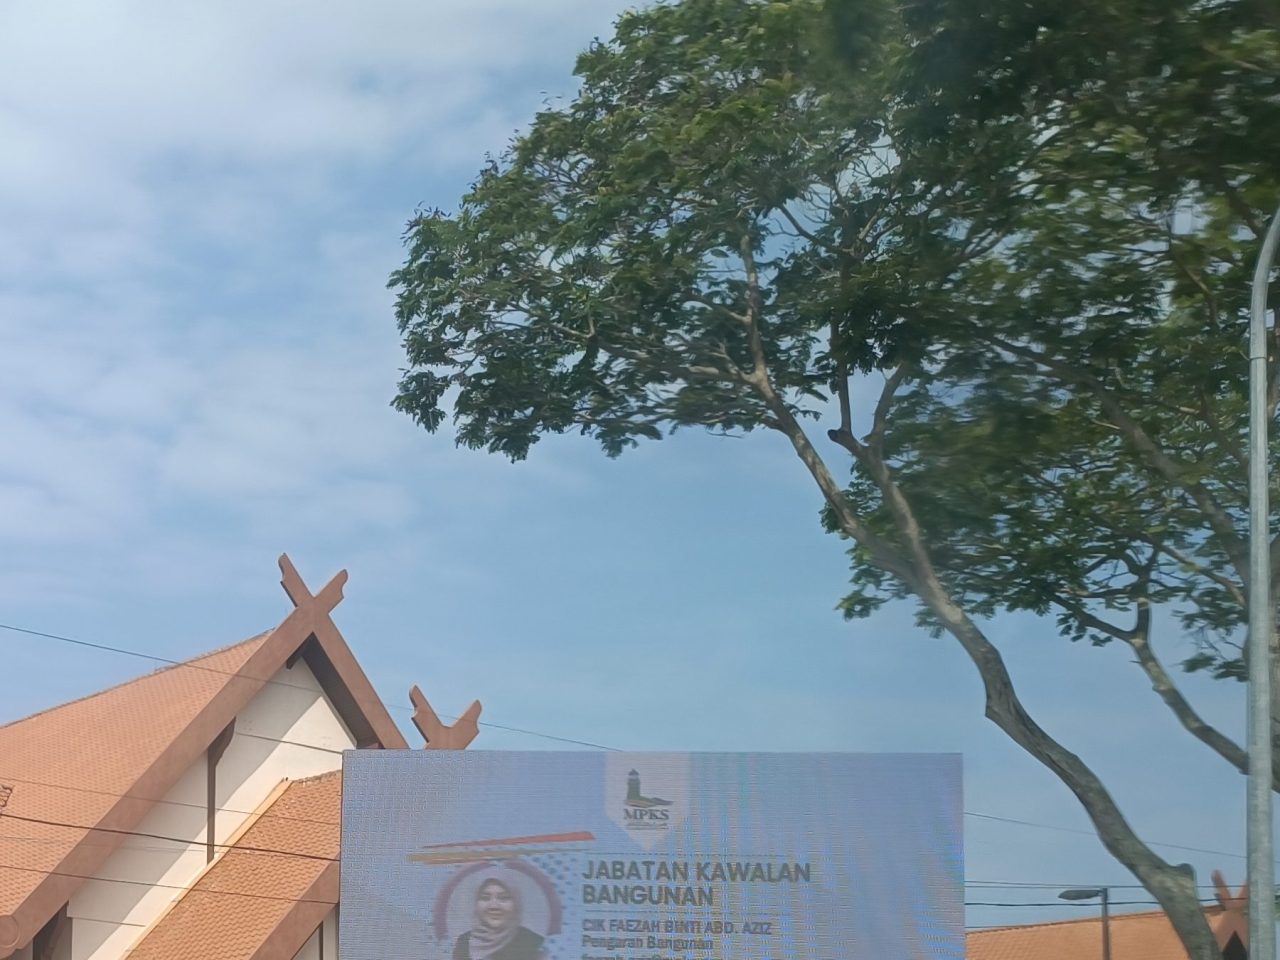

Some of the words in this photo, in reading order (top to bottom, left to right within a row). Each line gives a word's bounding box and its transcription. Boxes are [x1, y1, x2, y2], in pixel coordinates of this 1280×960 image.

[623, 808, 669, 820] MPKS
[582, 861, 688, 881] JABATAN
[695, 862, 811, 882] KAWALAN
[582, 884, 714, 906] BANGUNAN
[582, 919, 605, 932] CIK
[609, 919, 660, 933] FAEZAH
[664, 920, 700, 934] BINTI
[704, 920, 738, 934] ABD.
[743, 921, 772, 935] AZIZ
[582, 934, 643, 951] Pengarah
[647, 935, 714, 952] Bangunan
